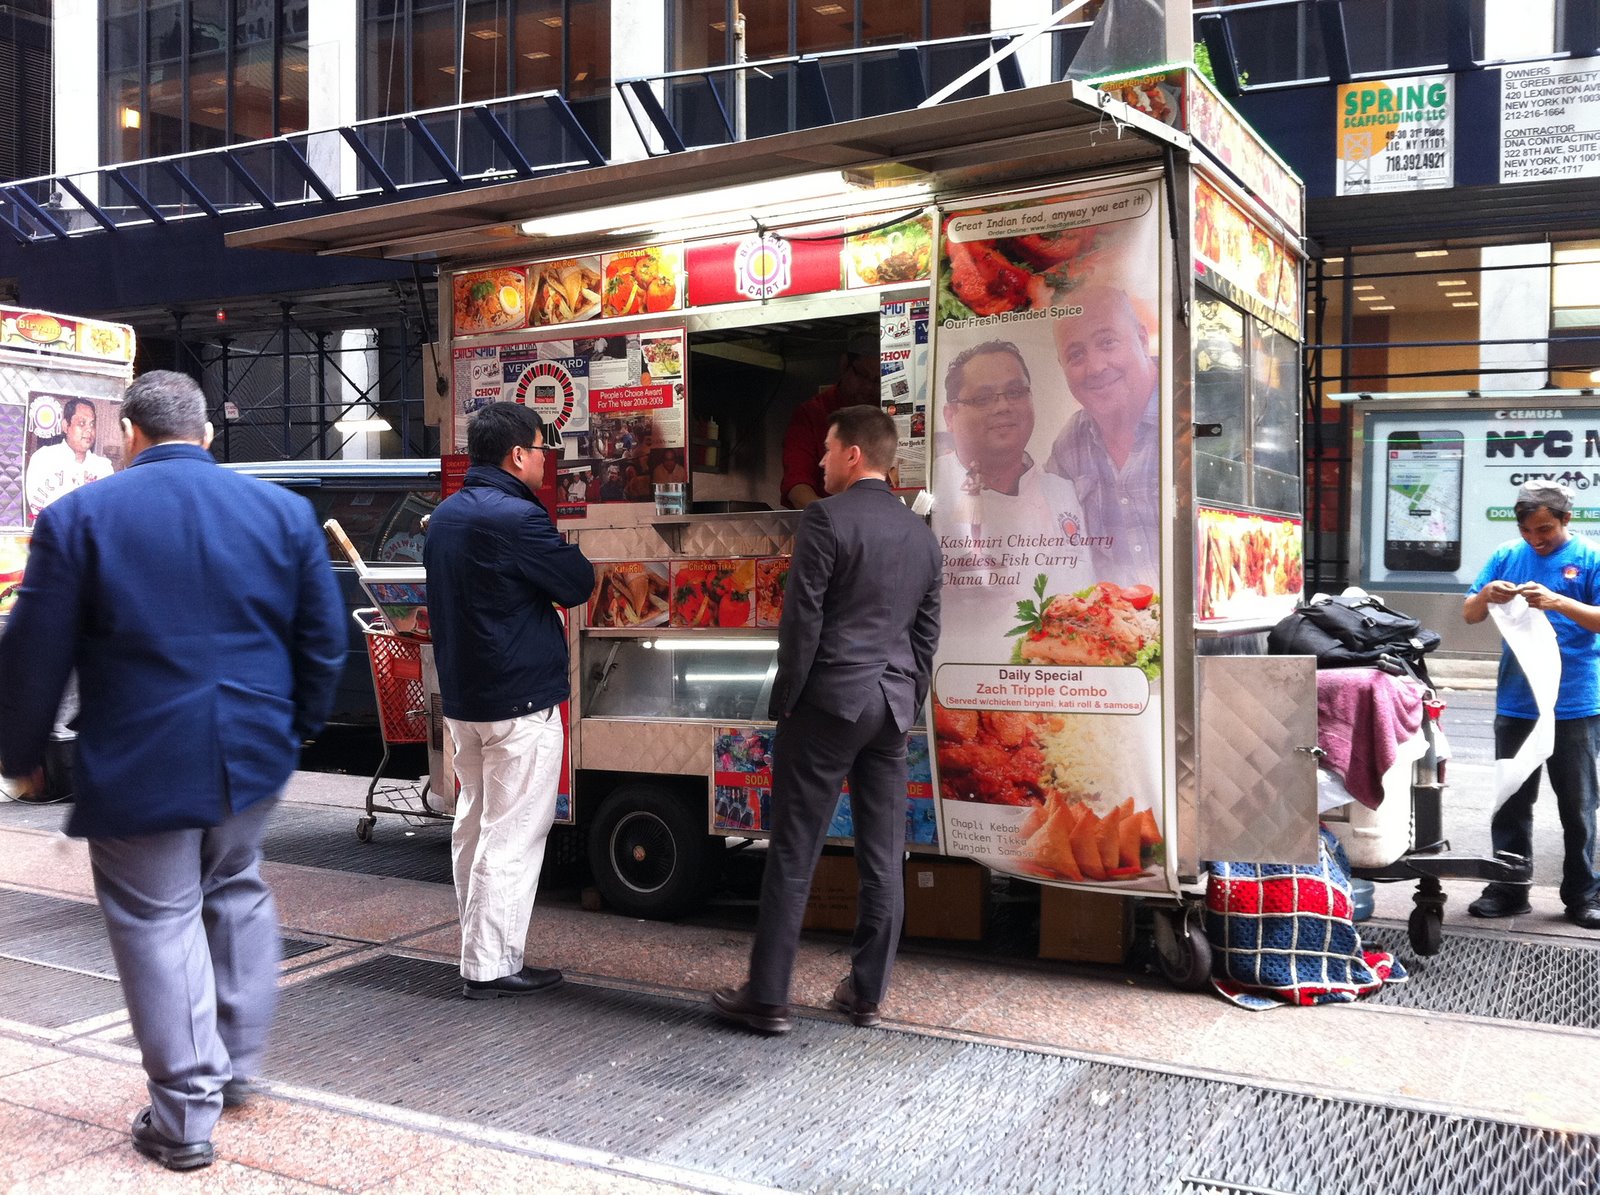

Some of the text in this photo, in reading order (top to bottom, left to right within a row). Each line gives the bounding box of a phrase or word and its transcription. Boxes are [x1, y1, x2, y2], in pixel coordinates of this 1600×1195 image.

[1505, 67, 1551, 79] OWNERS
[1505, 73, 1598, 90] SL GREEN REALTY
[1344, 83, 1447, 116] SPRING
[1505, 91, 1521, 100] 420
[1523, 85, 1582, 98] LEXINGTON
[1505, 101, 1529, 110] NEW
[1531, 98, 1560, 108] YORK
[1561, 96, 1576, 105] NY
[1344, 109, 1446, 128] SCAFFOLDING LLC
[1505, 107, 1566, 120] 212-216-1664
[1424, 127, 1445, 137] Place
[1504, 124, 1576, 138] CONTRACTOR
[1406, 140, 1418, 150] NY
[1420, 138, 1445, 148] 11101
[1504, 133, 1600, 148] DNA CONTRACTING
[1504, 143, 1598, 158] 322 8TH AVE, SUITE
[1385, 152, 1445, 172] 718.392.4921
[1504, 159, 1528, 168] NEW
[1529, 157, 1561, 166] YORK,
[1563, 155, 1578, 164] NY
[1504, 164, 1584, 178] PH: 212-647-1717
[954, 194, 1145, 232] Great Indian food, anyway you eat it!
[987, 228, 1006, 237] Order
[618, 250, 646, 260] Chicken
[748, 280, 780, 297] CART
[944, 305, 1083, 330] Our Fresh Blended Spice
[475, 387, 501, 397] CHOW
[600, 386, 663, 400] People's Choice Award
[598, 401, 608, 409] For
[608, 400, 620, 408] The
[620, 398, 633, 408] Year
[1510, 410, 1563, 419] CEMUSA
[1486, 430, 1573, 458] NYC
[940, 532, 1114, 550] Kashmiri Chicken Curry
[688, 562, 737, 571] Chicken Tikka
[941, 552, 1079, 569] Boneless Fish Curry
[942, 572, 1021, 586] Chana Daal
[999, 669, 1083, 684] Daily Special
[976, 683, 1108, 698] Zach Tripple Combo
[945, 696, 1144, 710] (Served w/chicken biryani, kati roll & samosa)
[744, 774, 770, 786] SODA
[950, 817, 1020, 834] Chapli Kebab
[951, 829, 1028, 846] Chicken Tikka
[952, 840, 1034, 858] Punjabi Samosa
